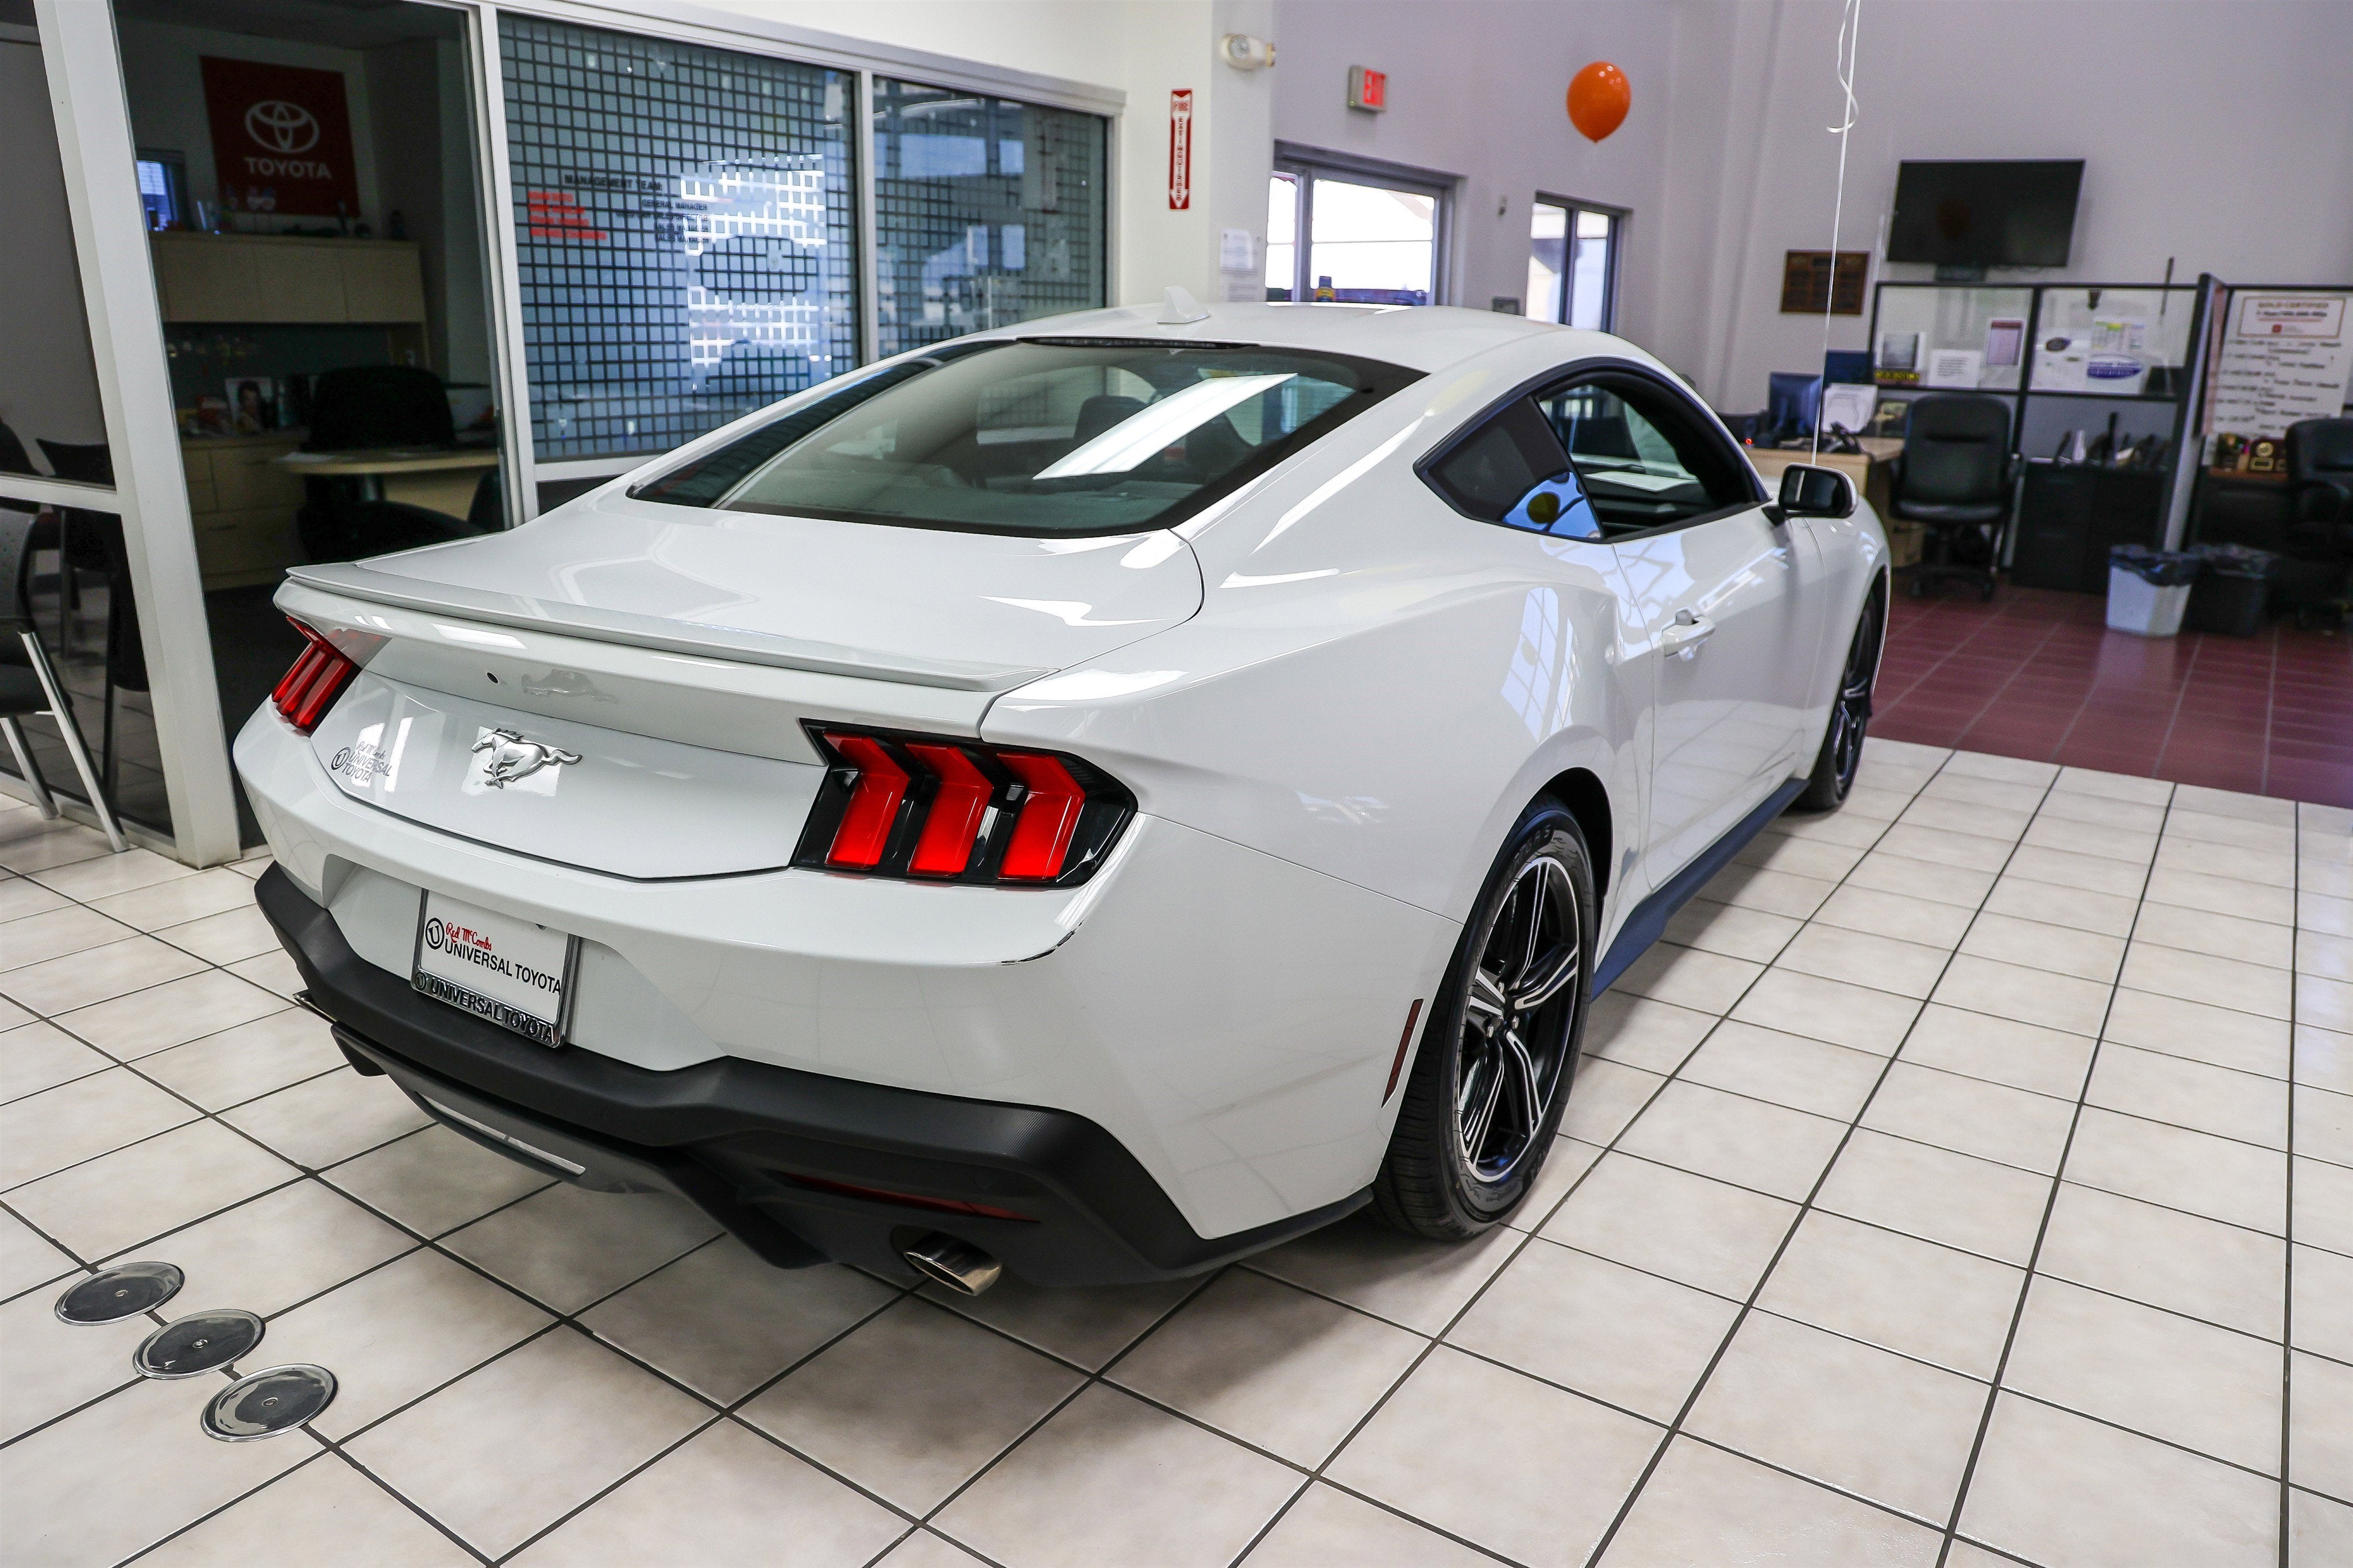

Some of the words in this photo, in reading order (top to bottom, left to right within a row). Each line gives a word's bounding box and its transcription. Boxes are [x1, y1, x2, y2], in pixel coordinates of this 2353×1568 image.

[244, 156, 332, 180] TOYOTA
[342, 762, 373, 782] TOYOTA
[349, 751, 392, 777] UNIVERSAL
[445, 922, 460, 944] Red
[445, 939, 513, 978] UNIVERSAL
[515, 963, 561, 996] TOYOTA
[431, 977, 502, 1020] UNIVERSAL
[503, 1006, 556, 1044] TOYOTA
